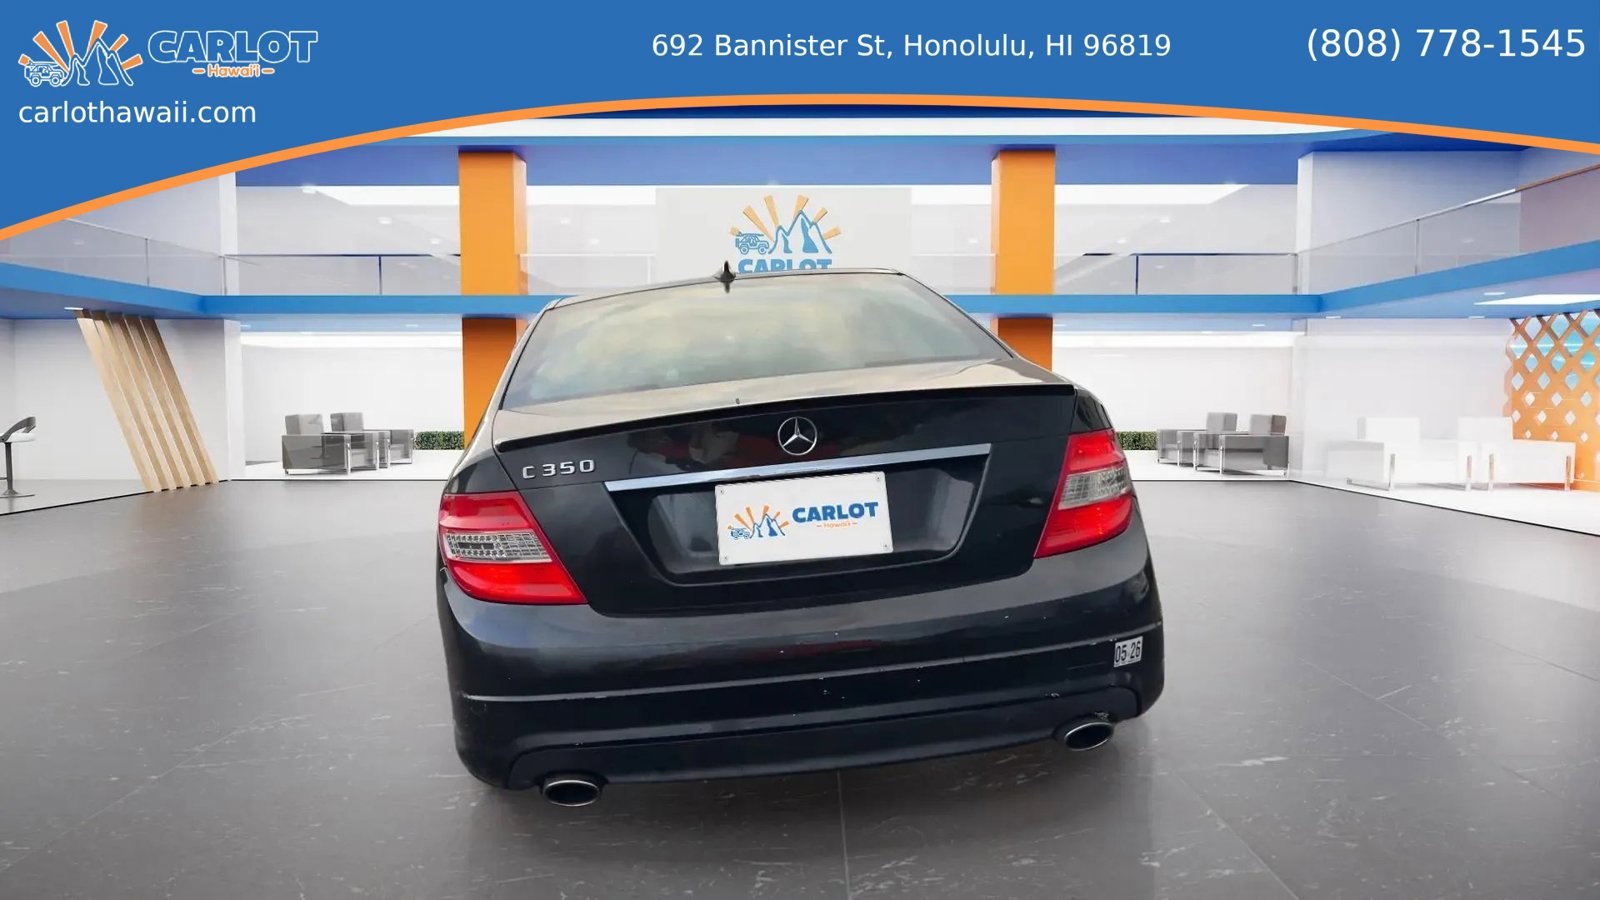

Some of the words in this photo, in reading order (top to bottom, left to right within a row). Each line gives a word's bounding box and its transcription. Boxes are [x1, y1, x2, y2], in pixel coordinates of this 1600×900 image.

[522, 465, 536, 479] C
[542, 459, 595, 477] 350
[792, 501, 879, 524] CARLOT
[1115, 644, 1127, 663] 05
[1130, 640, 1141, 659] 26
